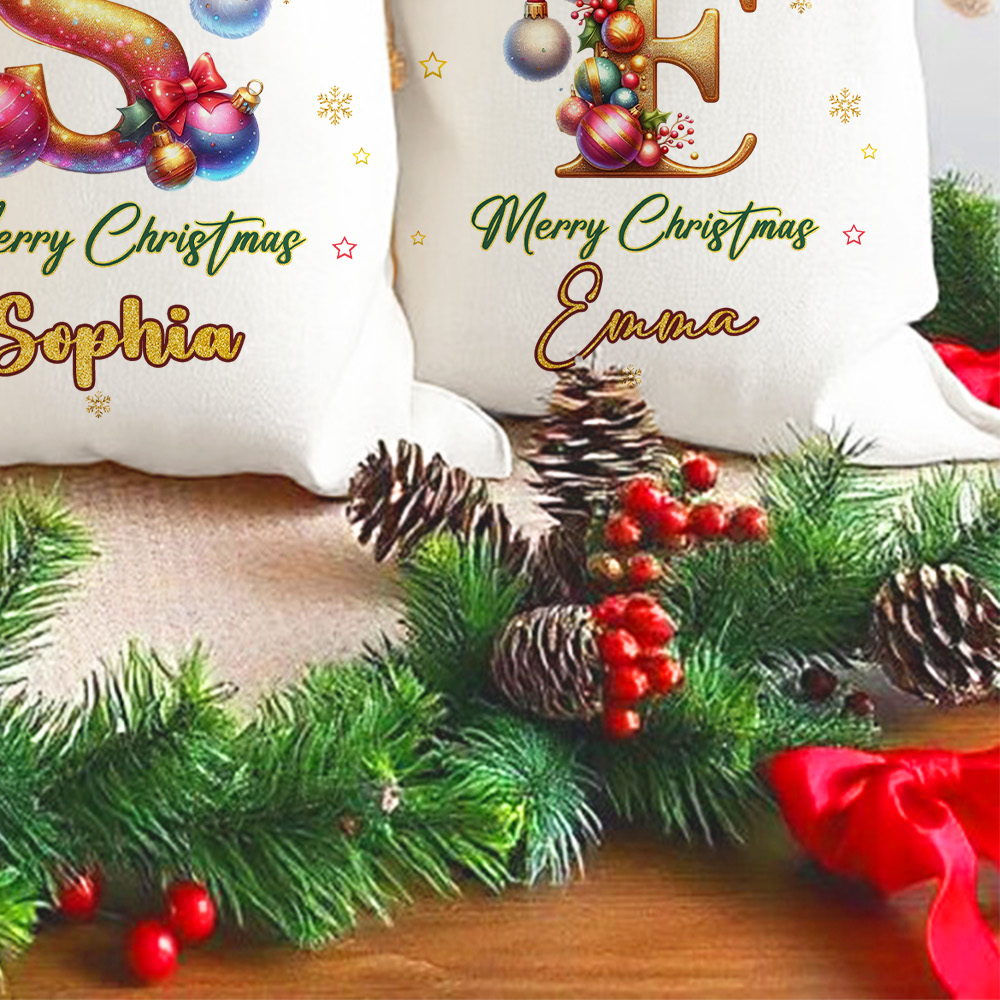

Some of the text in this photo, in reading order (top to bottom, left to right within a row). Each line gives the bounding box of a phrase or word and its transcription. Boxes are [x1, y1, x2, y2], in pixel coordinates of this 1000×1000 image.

[85, 201, 307, 276] Christmas
[470, 190, 820, 261] Merry Christmas
[534, 261, 760, 372] Emma
